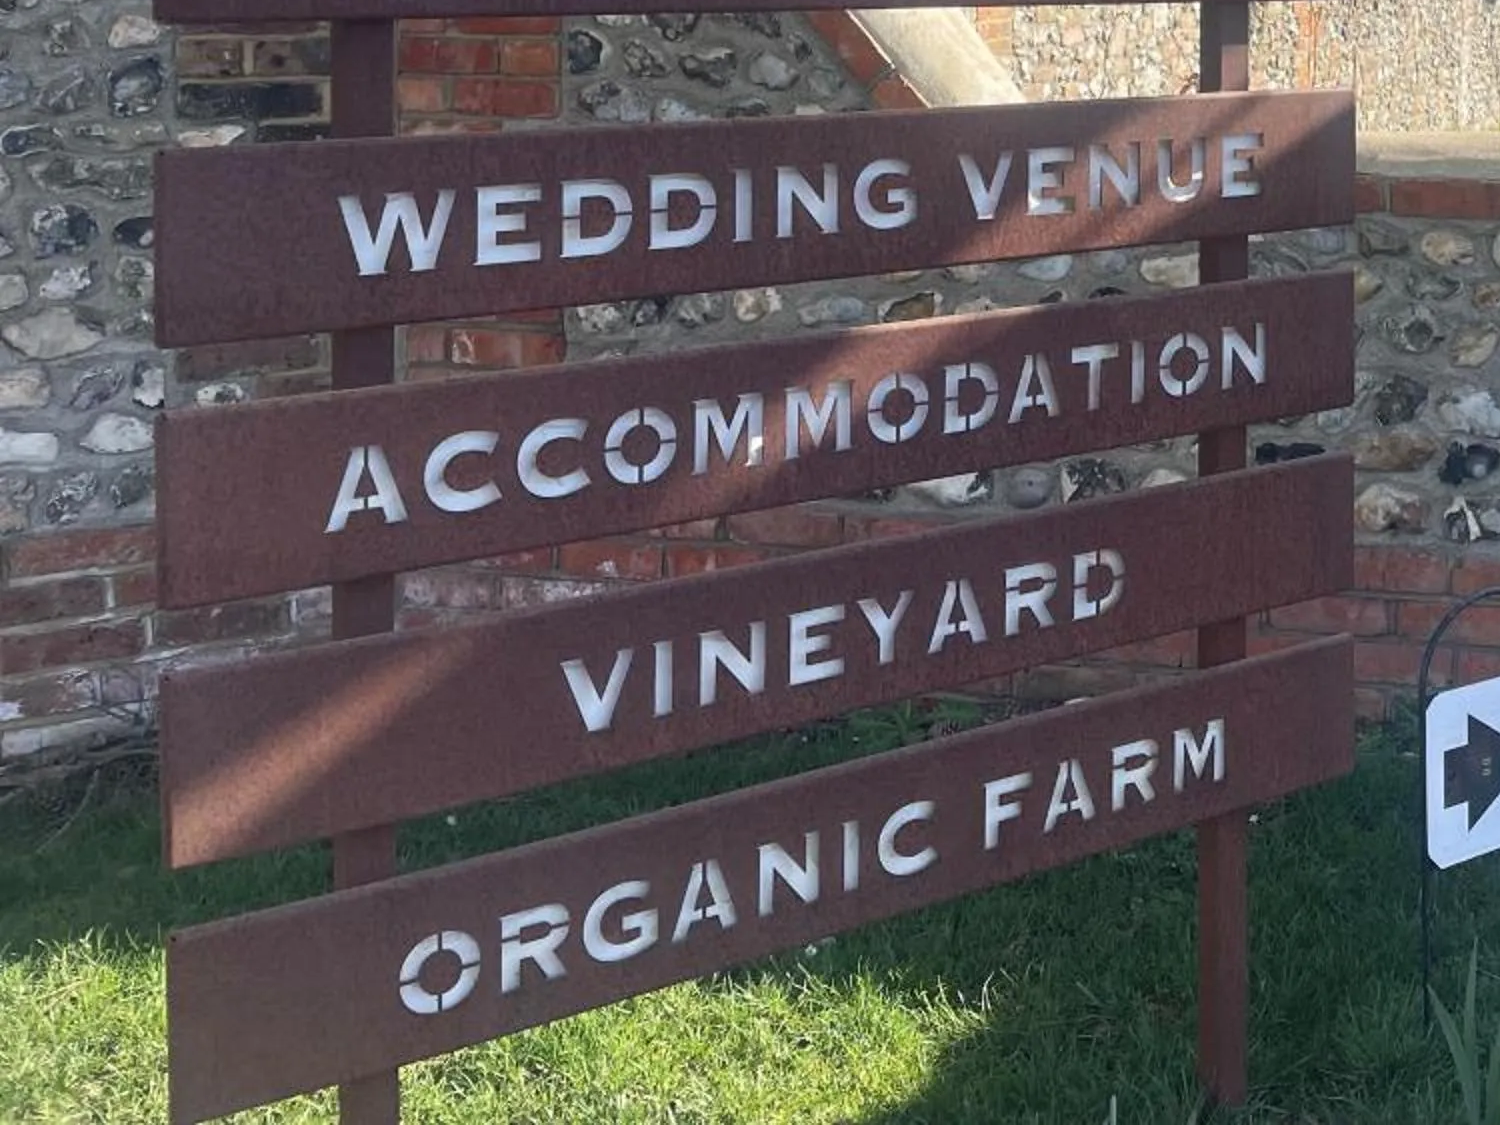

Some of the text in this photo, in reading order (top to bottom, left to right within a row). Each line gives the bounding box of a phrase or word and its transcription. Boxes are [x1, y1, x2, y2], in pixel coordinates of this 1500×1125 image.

[338, 132, 1263, 276] WEDDING VENUE
[324, 322, 1267, 534] ACCOMMODATION
[560, 548, 1125, 732] VINEYARD
[400, 718, 1227, 1013] ORGANIC FARM
